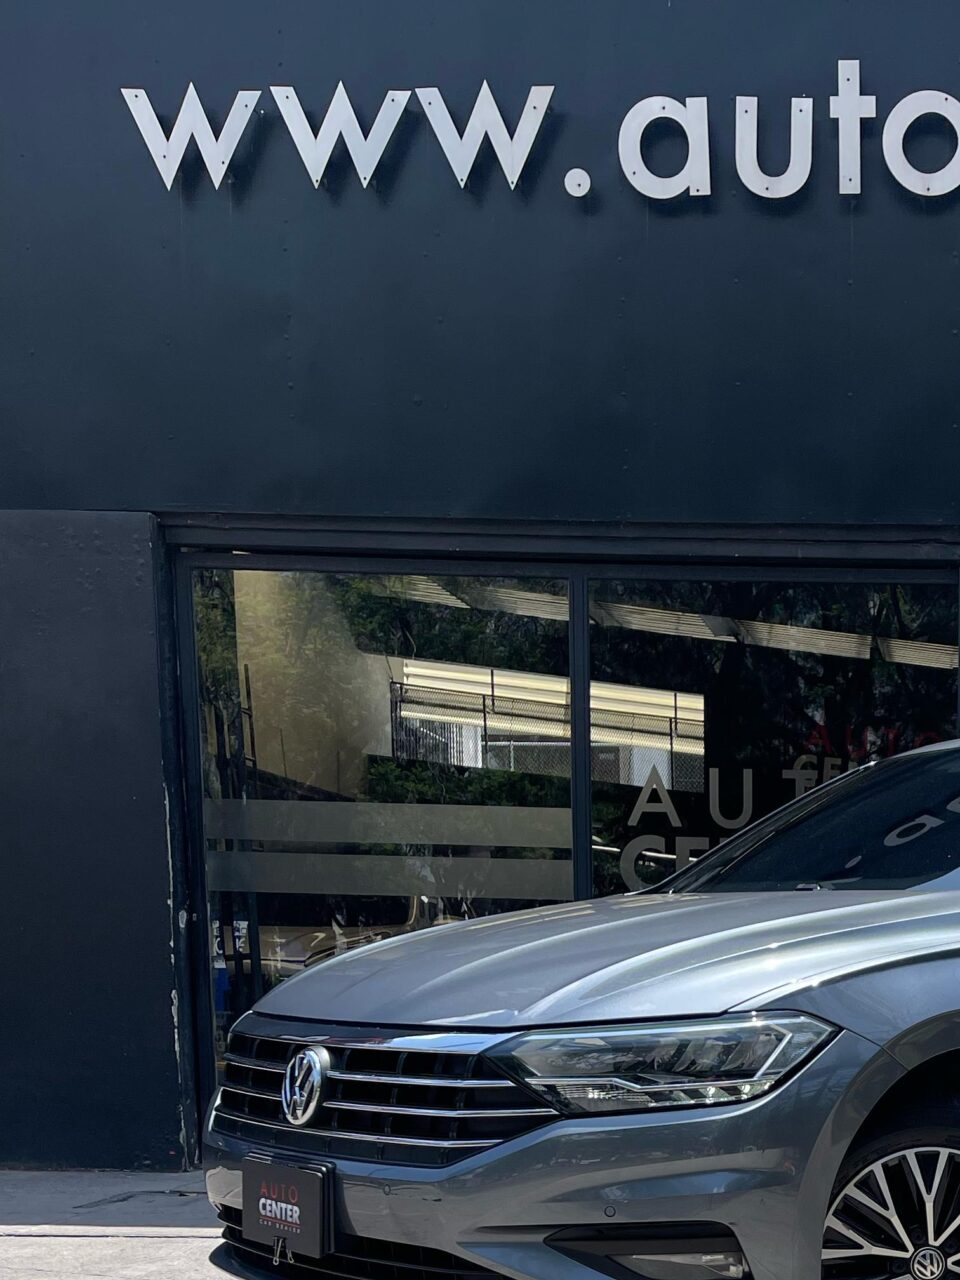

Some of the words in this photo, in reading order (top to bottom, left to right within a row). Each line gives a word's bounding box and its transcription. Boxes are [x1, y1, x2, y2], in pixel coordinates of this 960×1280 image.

[627, 764, 818, 830] AUT
[260, 1182, 298, 1203] AUTO
[258, 1197, 300, 1225] CENTER
